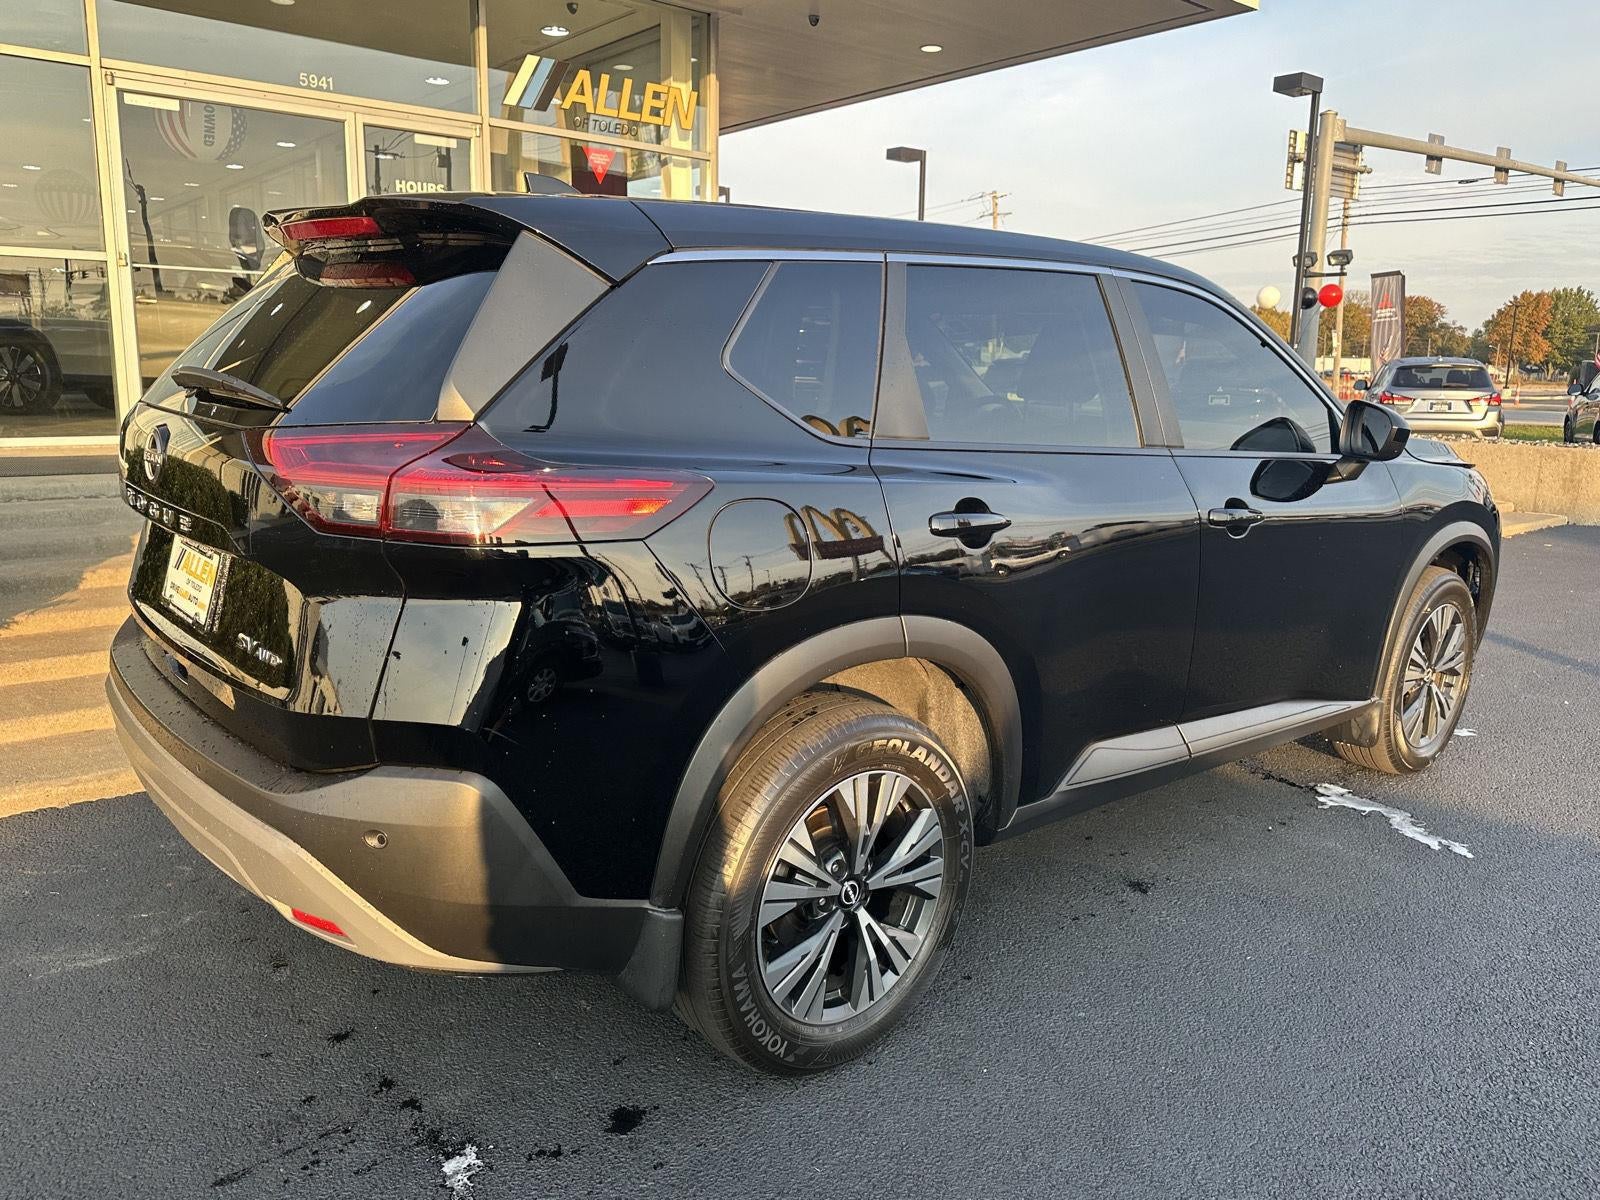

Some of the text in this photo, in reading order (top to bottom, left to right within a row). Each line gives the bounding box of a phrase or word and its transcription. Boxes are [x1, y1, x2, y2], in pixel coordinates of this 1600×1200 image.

[299, 73, 334, 90] 5941
[561, 69, 698, 130] ALLEN
[203, 104, 215, 147] OWNED
[573, 116, 638, 136] OF TOLEDO
[395, 179, 446, 193] HOURS
[181, 549, 214, 588] ALLEN
[855, 738, 966, 814] GEOLANDAR
[732, 962, 788, 1058] YOKOHAMA
